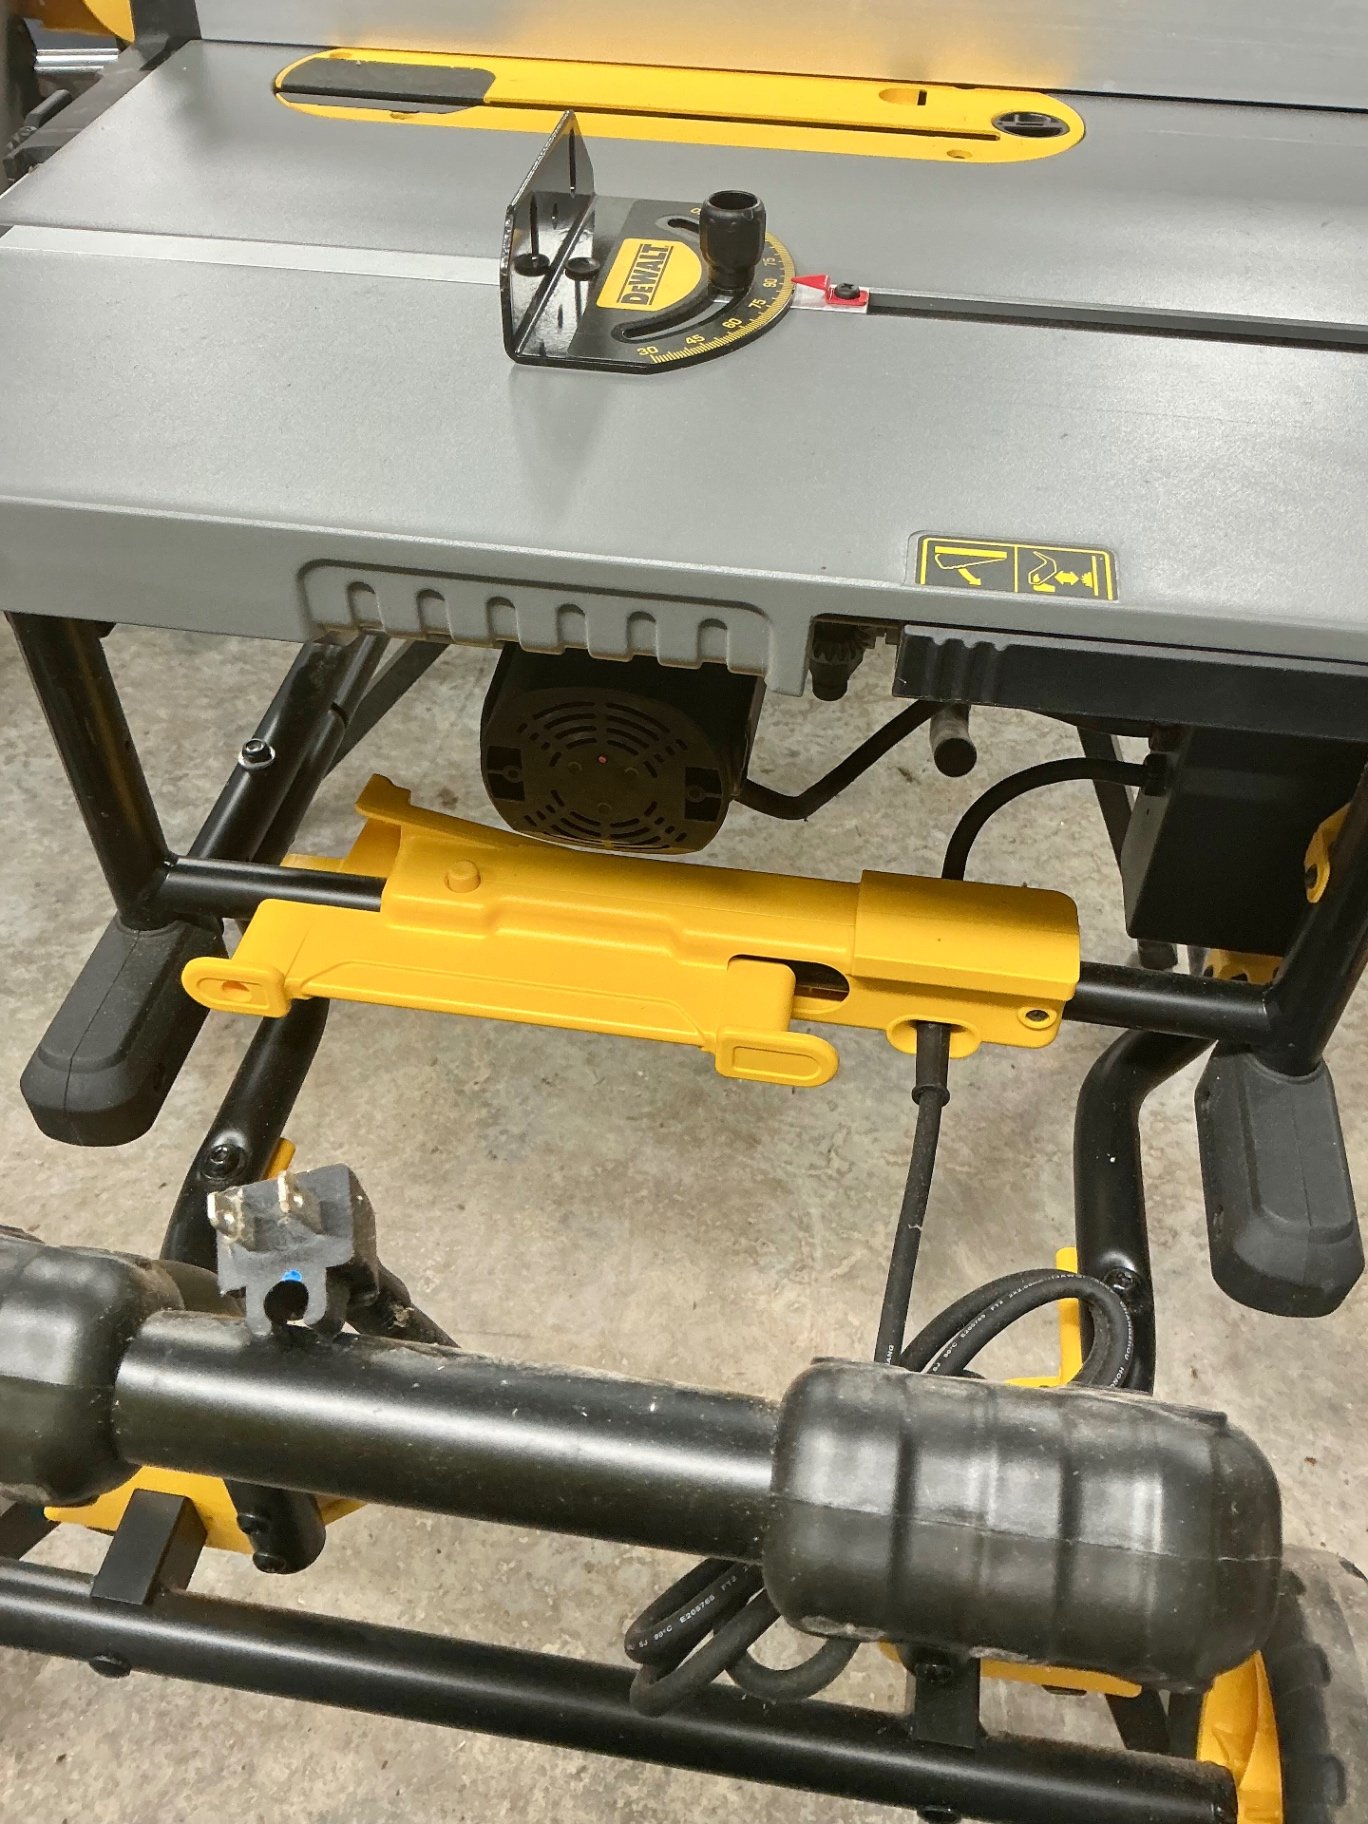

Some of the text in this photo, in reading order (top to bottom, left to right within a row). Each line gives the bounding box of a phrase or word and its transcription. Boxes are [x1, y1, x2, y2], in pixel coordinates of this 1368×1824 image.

[620, 243, 670, 306] DEWALT
[636, 256, 778, 356] 30 45 60 75 90 75
